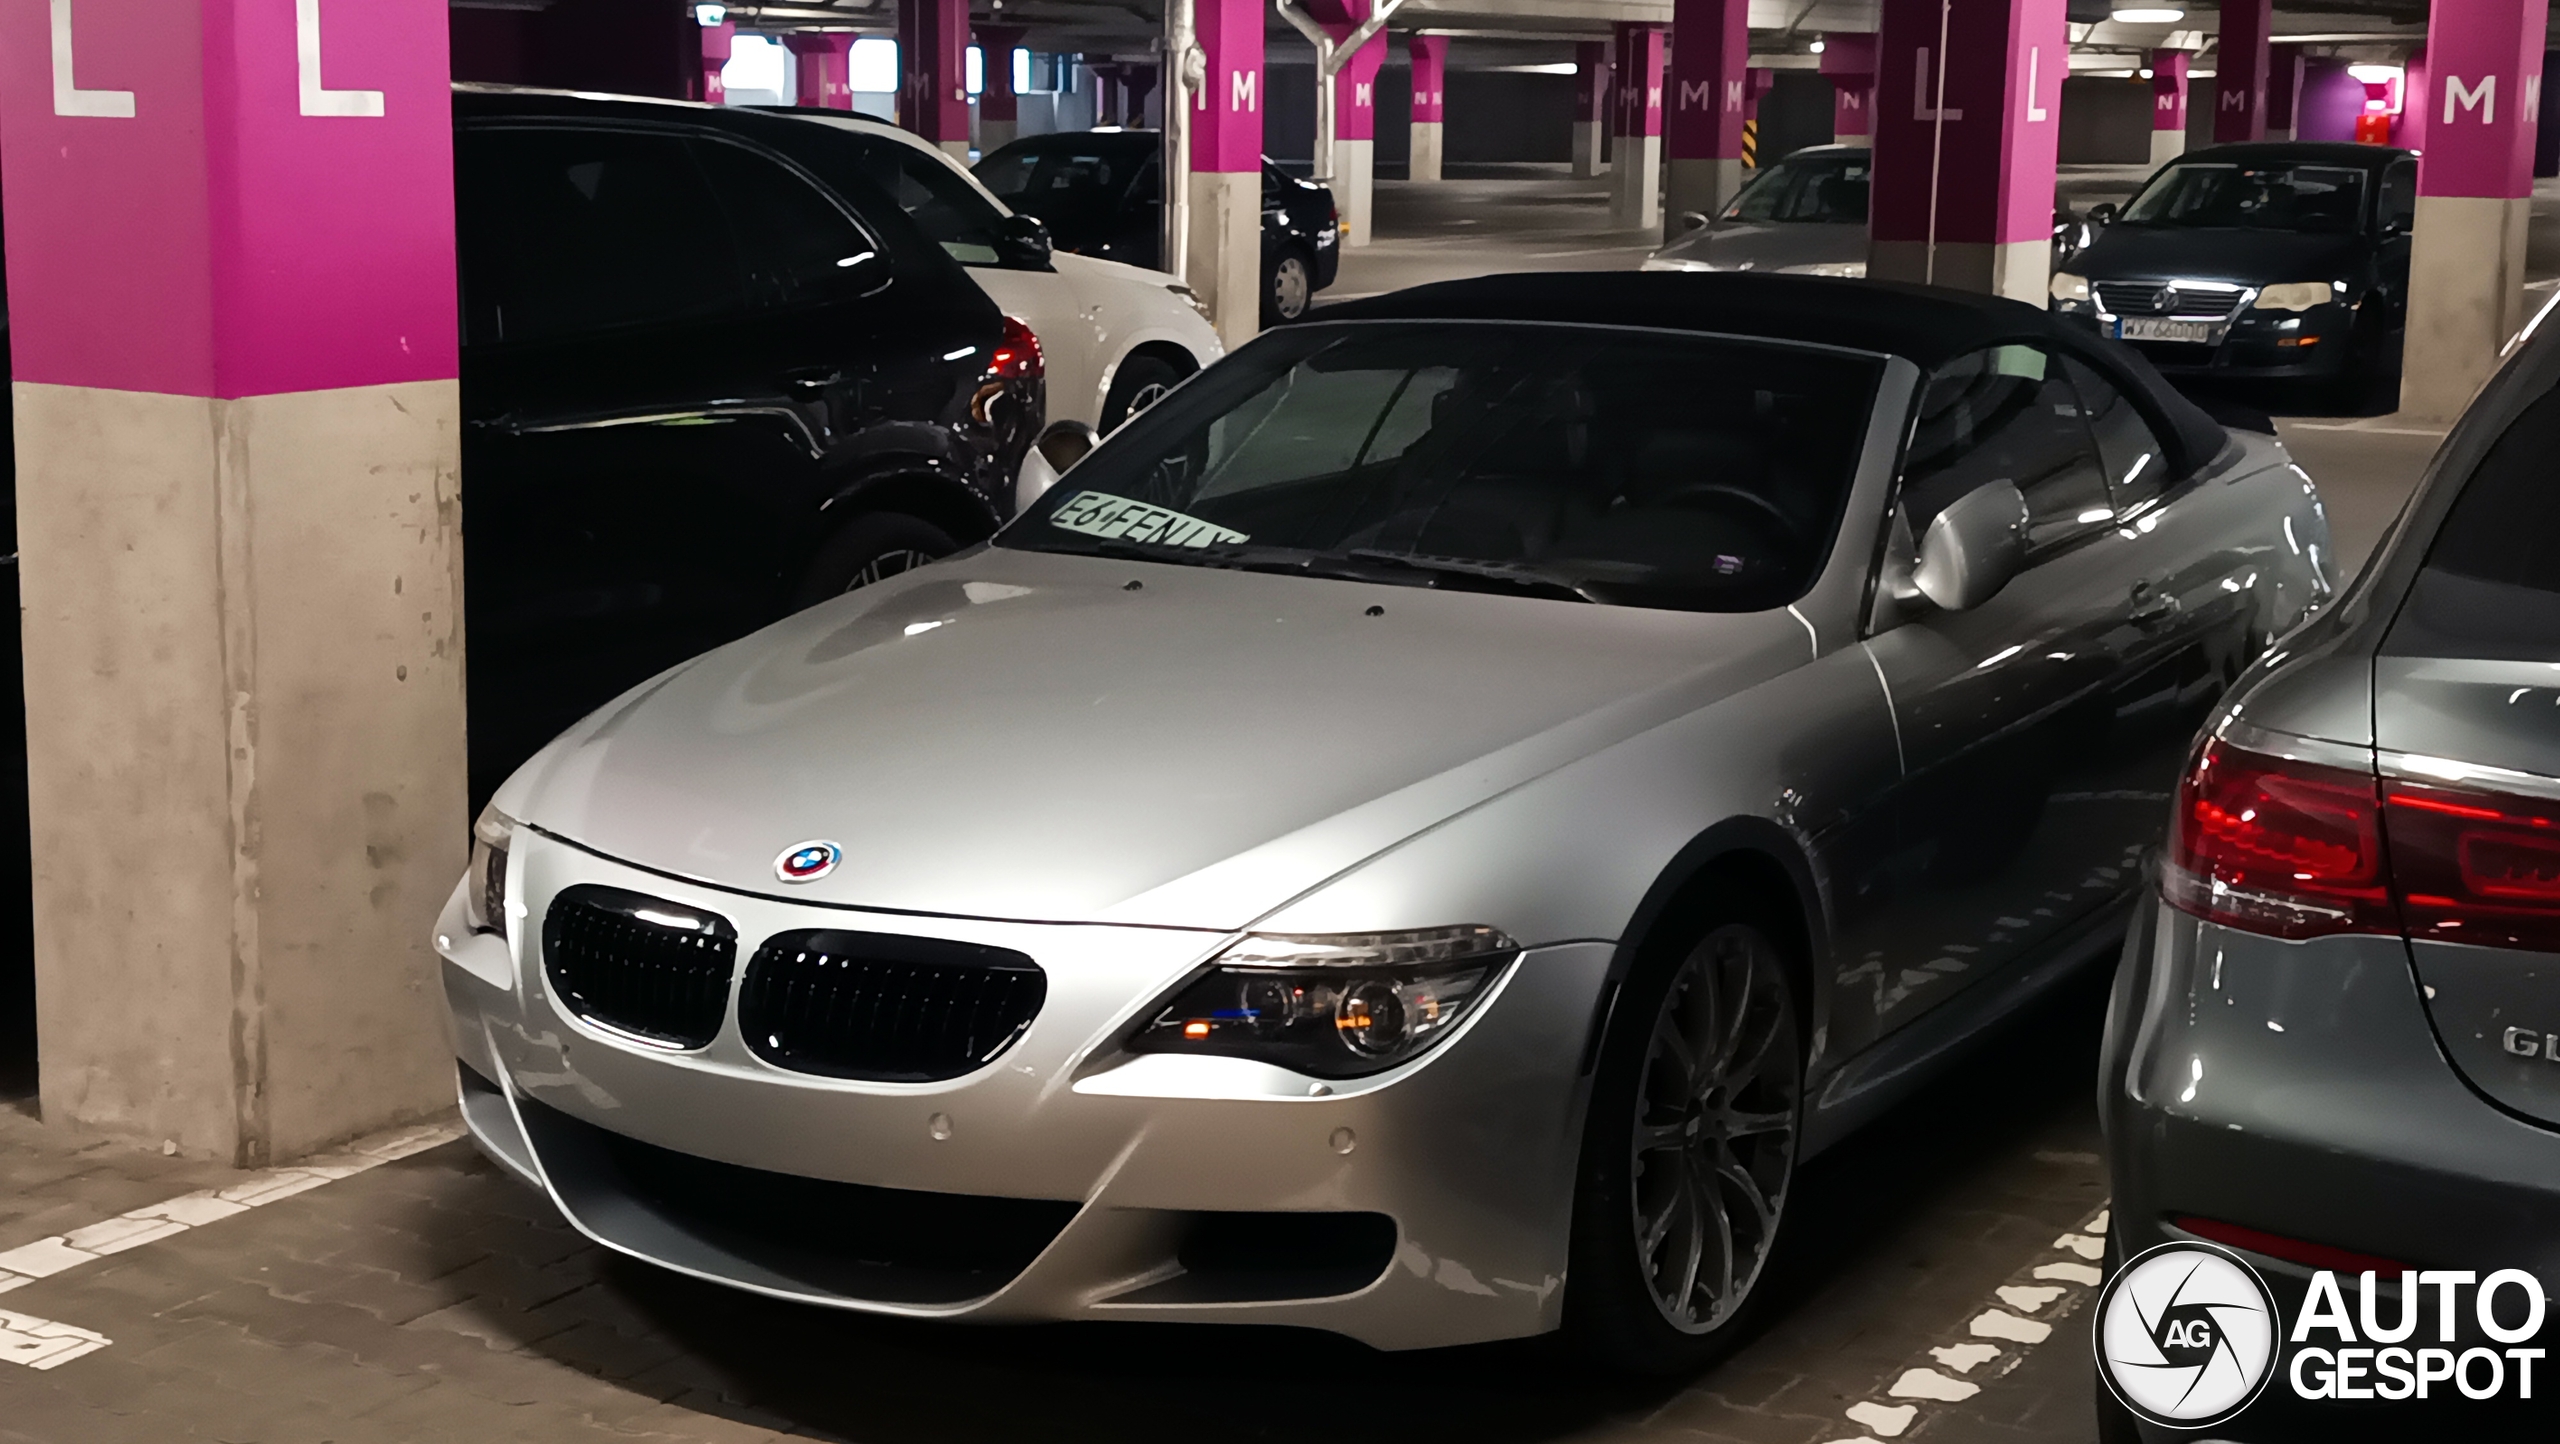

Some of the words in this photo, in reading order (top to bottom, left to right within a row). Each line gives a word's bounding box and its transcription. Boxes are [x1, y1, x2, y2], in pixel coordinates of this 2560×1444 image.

[50, 0, 136, 118] L
[295, 0, 385, 117] L
[1232, 70, 1256, 112] M
[1355, 83, 1372, 107] M
[1620, 86, 1639, 107] M
[1680, 80, 1709, 111] M
[1726, 80, 1742, 112] M
[1913, 46, 1963, 121] L
[2027, 46, 2046, 122] L
[2443, 75, 2496, 124] M
[1842, 91, 1860, 110] N
[2158, 95, 2174, 110] N
[2221, 90, 2244, 112] M
[1050, 494, 1117, 526] E6
